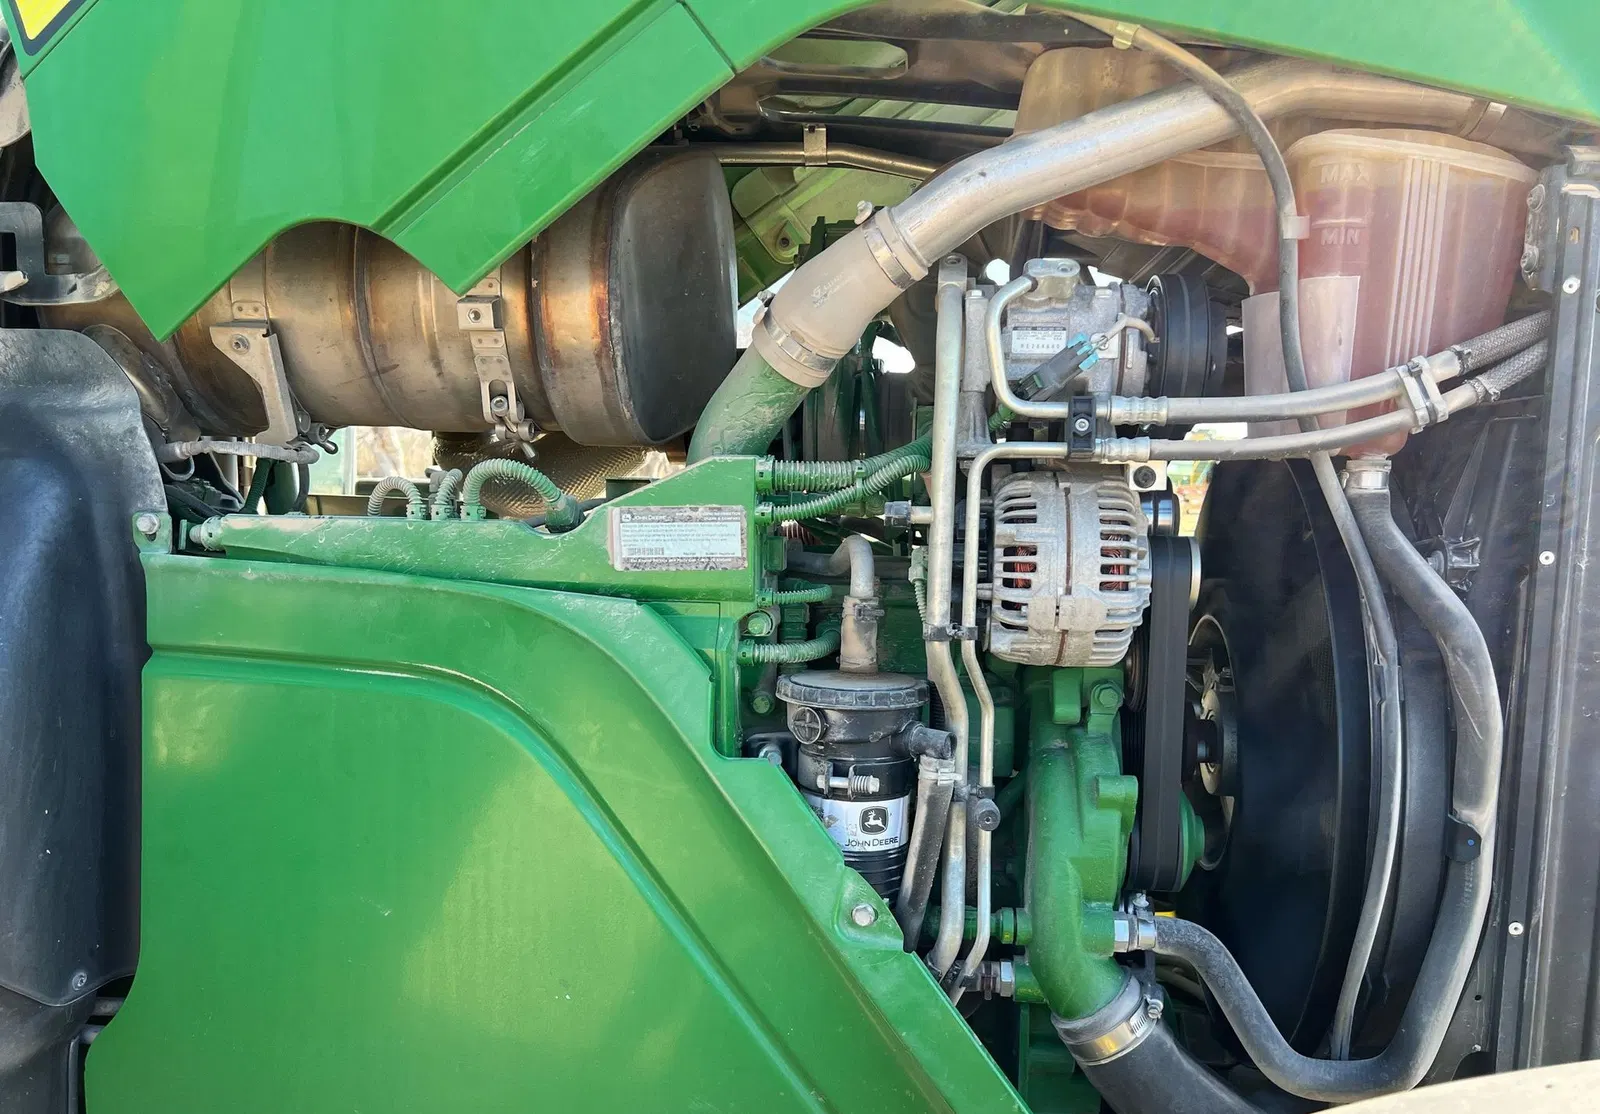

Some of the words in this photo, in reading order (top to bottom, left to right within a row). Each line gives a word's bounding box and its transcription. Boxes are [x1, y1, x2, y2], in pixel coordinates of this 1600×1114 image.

[1321, 163, 1370, 183] MAX
[1321, 227, 1360, 246] MIN
[845, 839, 870, 847] JOHN
[872, 836, 899, 846] DEERE
